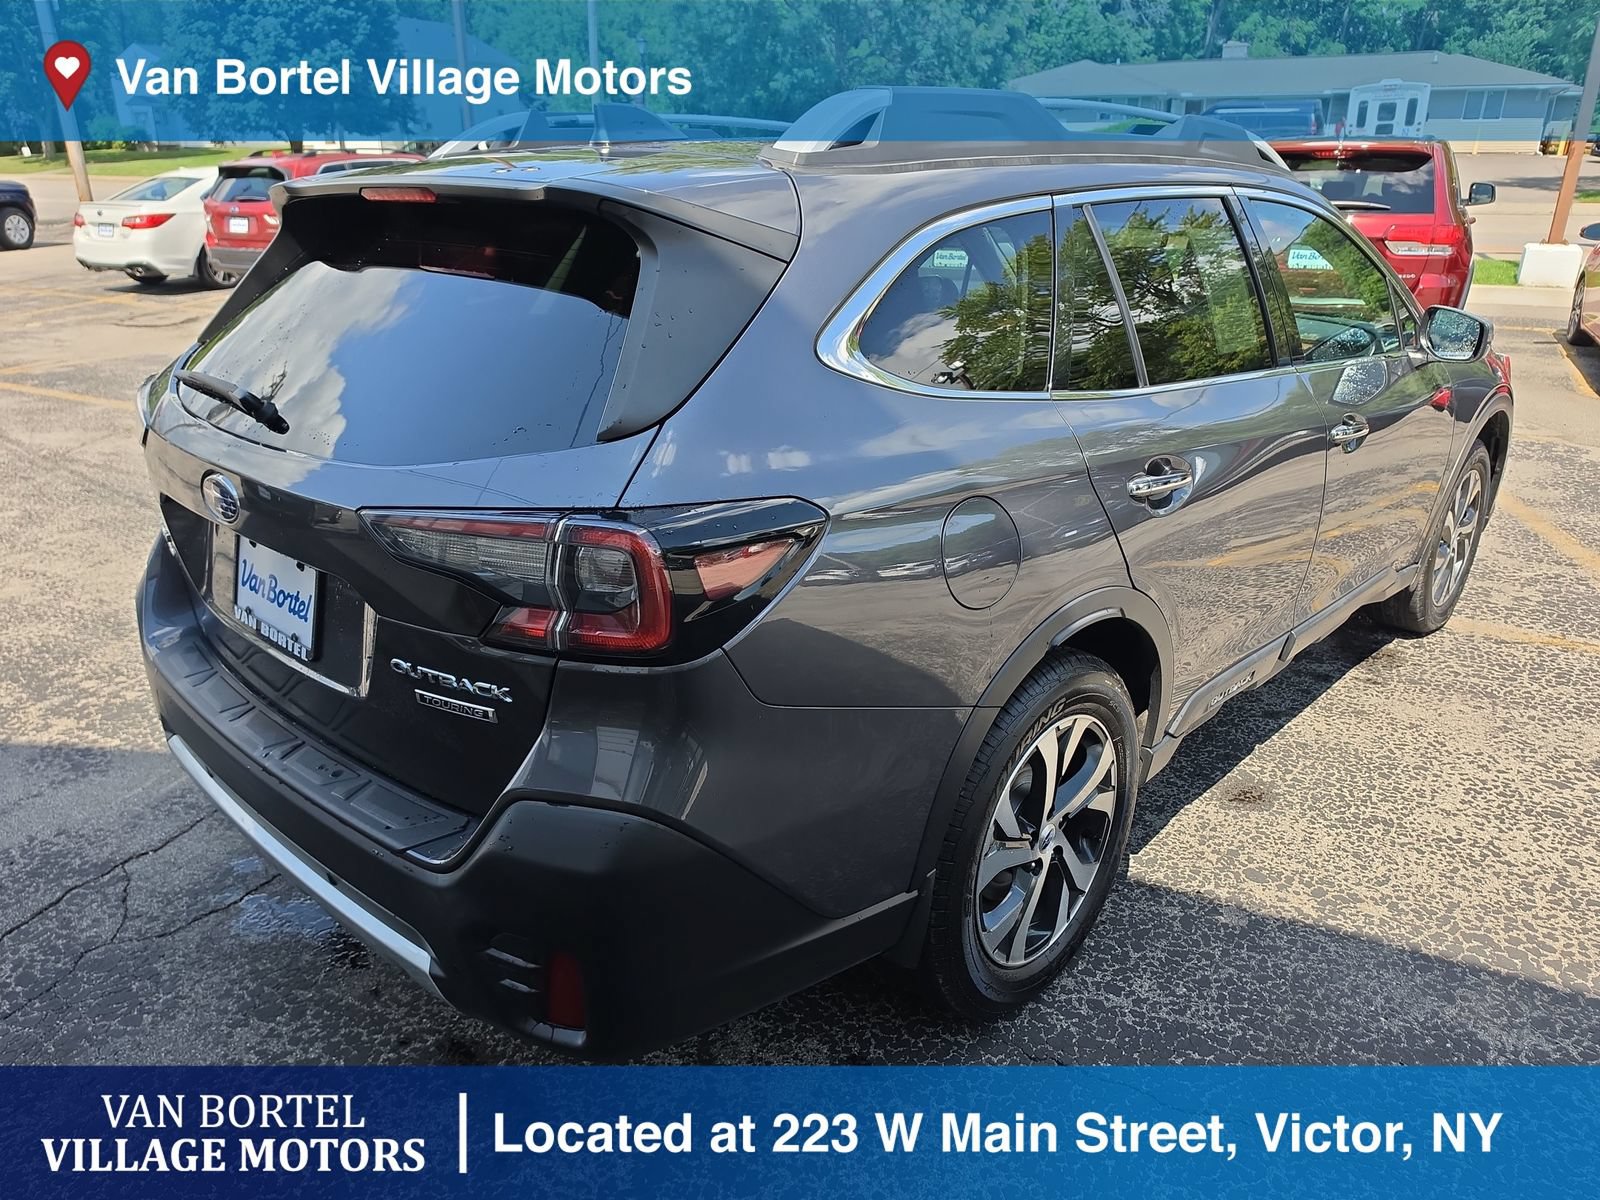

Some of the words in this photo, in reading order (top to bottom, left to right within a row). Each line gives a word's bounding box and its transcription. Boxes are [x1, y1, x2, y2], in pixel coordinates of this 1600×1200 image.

[234, 603, 257, 630] VAN
[260, 621, 309, 662] BORTEL
[390, 658, 513, 703] OUTBACK
[423, 694, 484, 718] TOURING
